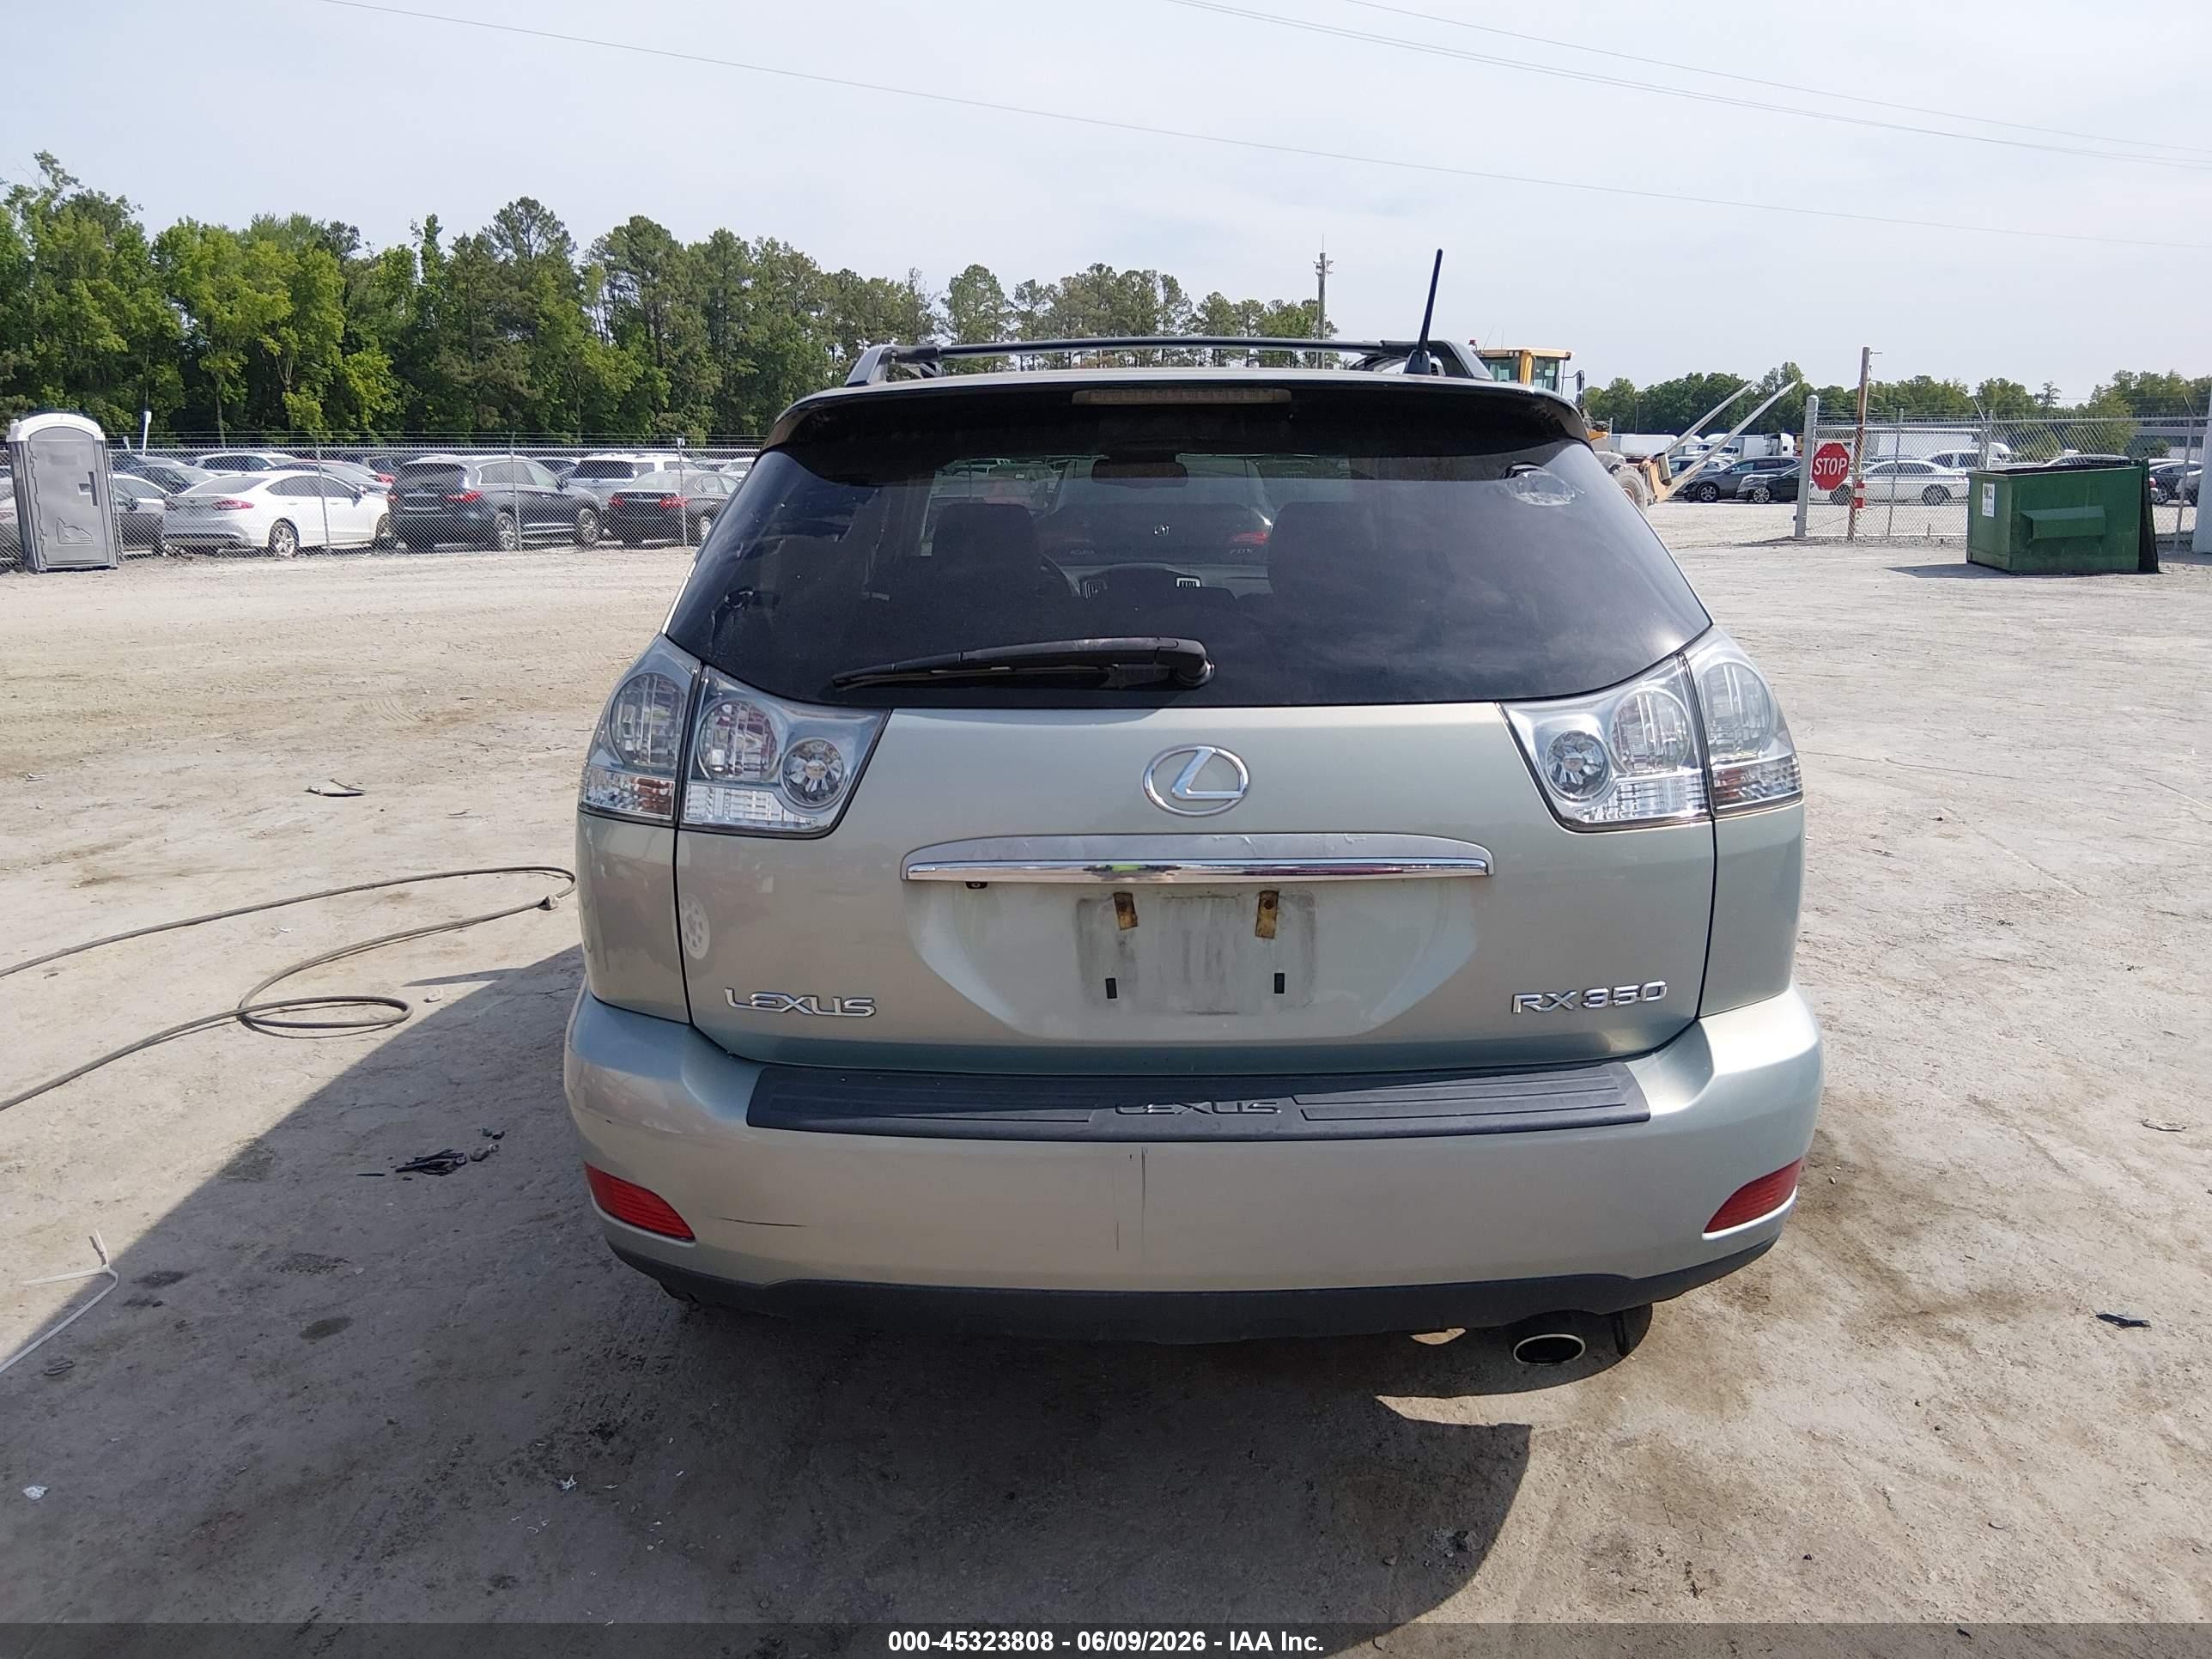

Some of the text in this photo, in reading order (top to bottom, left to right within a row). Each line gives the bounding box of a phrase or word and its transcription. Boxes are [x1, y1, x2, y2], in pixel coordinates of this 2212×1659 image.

[1814, 458, 1847, 476] STOP
[725, 988, 877, 1018] LEXUS
[1511, 981, 1668, 1014] RX 350
[1115, 1100, 1282, 1115] LEXUS
